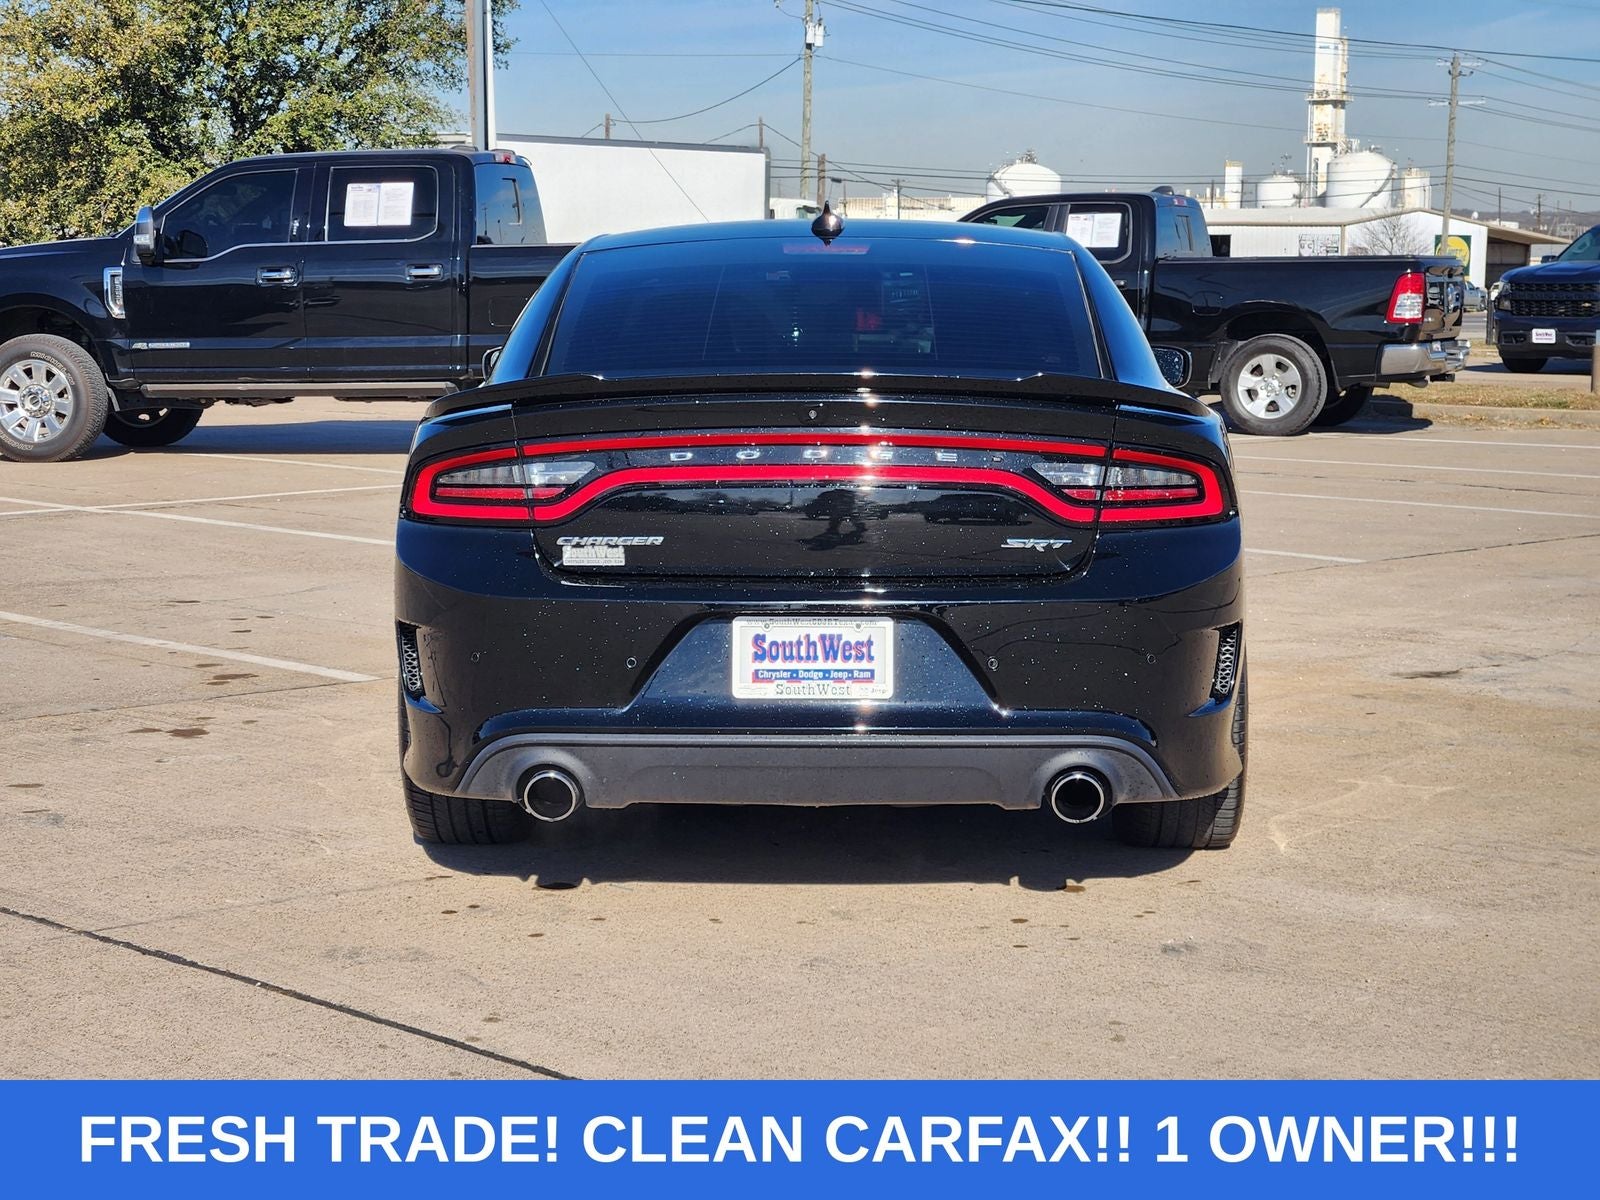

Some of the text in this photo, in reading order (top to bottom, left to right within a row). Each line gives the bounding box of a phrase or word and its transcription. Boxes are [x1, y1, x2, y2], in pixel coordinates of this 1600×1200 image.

[669, 449, 958, 463] DODGE
[556, 536, 664, 545] CHARGER
[1001, 538, 1073, 552] SRT
[752, 633, 875, 663] SouthWest
[758, 669, 871, 680] Chrysler Dodge Jeep Ram
[775, 683, 851, 696] SouthWest
